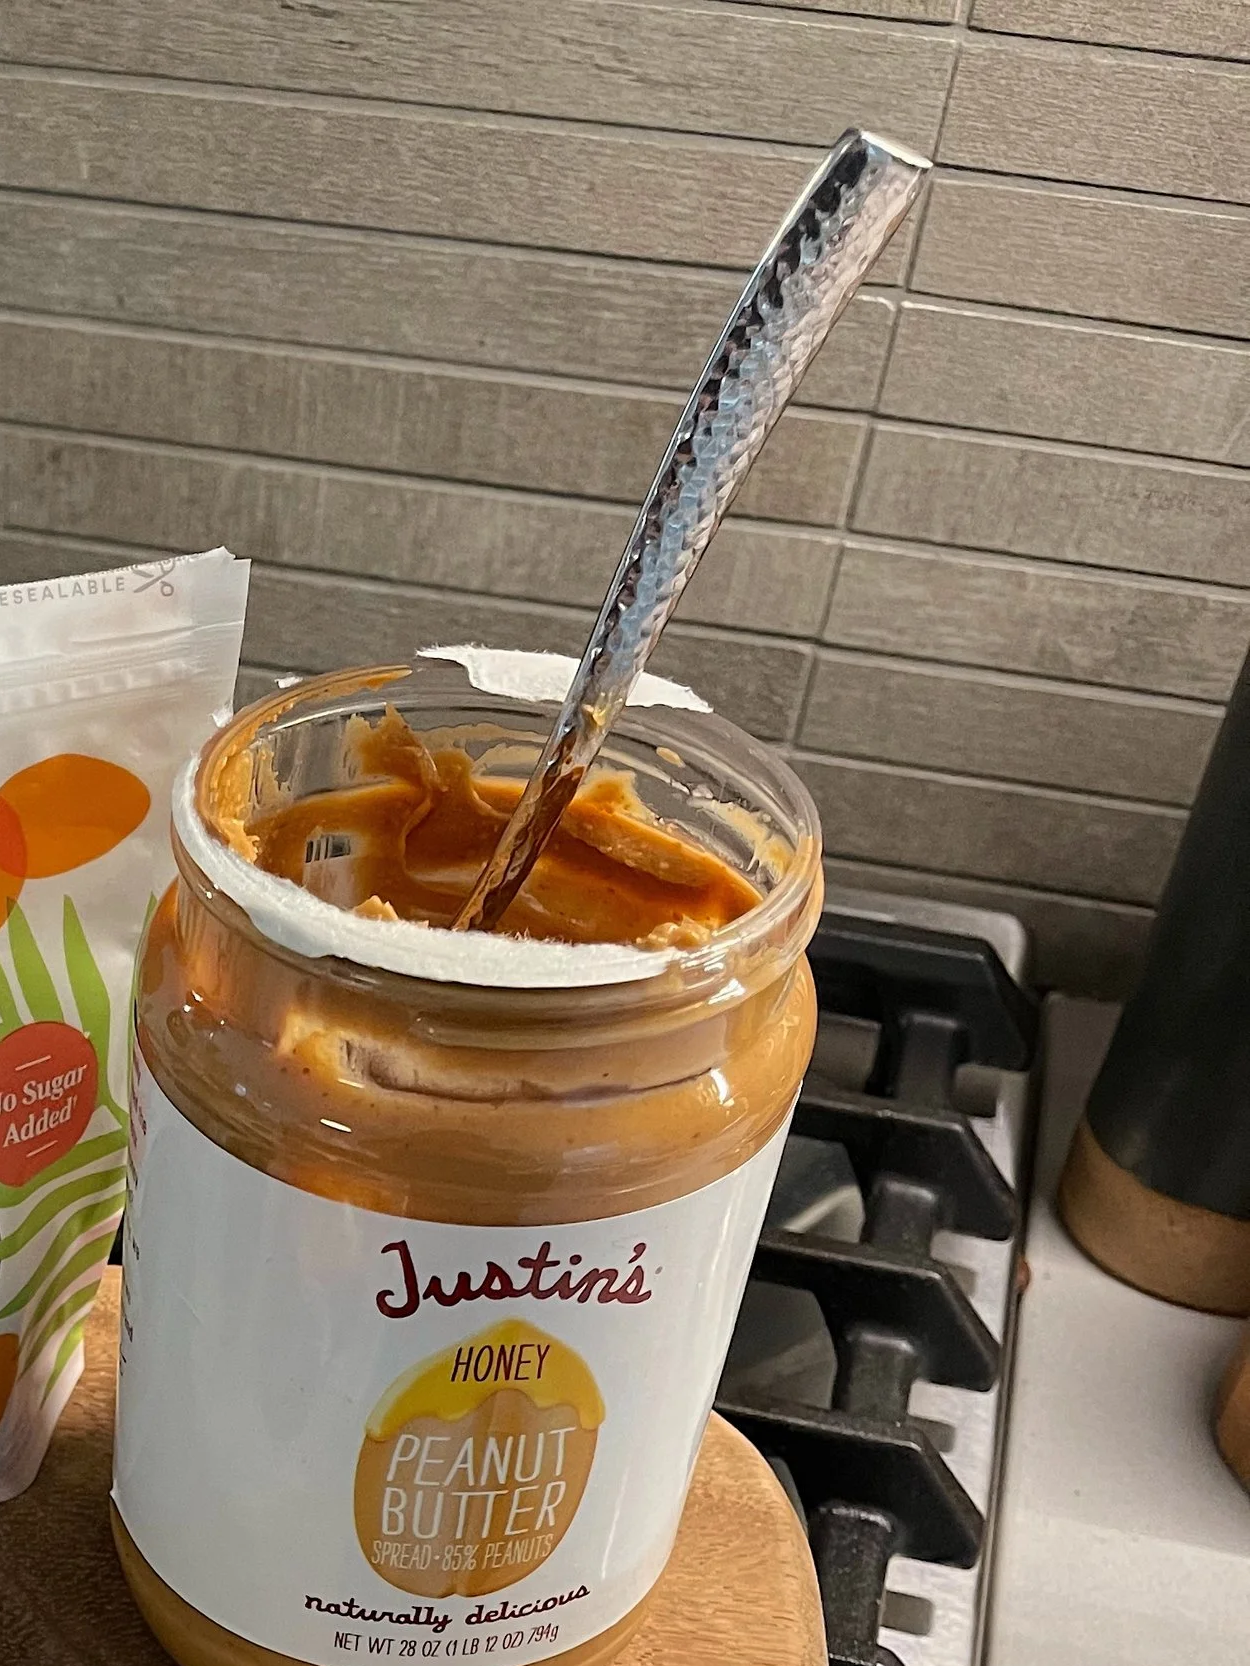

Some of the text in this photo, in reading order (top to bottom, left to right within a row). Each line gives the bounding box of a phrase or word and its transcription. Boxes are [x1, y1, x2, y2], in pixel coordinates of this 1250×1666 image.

[22, 1064, 88, 1105] Sugar
[375, 1239, 653, 1319] Justin's
[450, 1343, 551, 1383] HONEY
[386, 1426, 577, 1488] PEANUT
[381, 1480, 567, 1540] BUTTER
[481, 1533, 555, 1571] PEANUTS
[304, 1584, 591, 1633] naturally delicious
[334, 1622, 560, 1658] NET WT 28 OZ (1 LB 12 OZ) 794g
